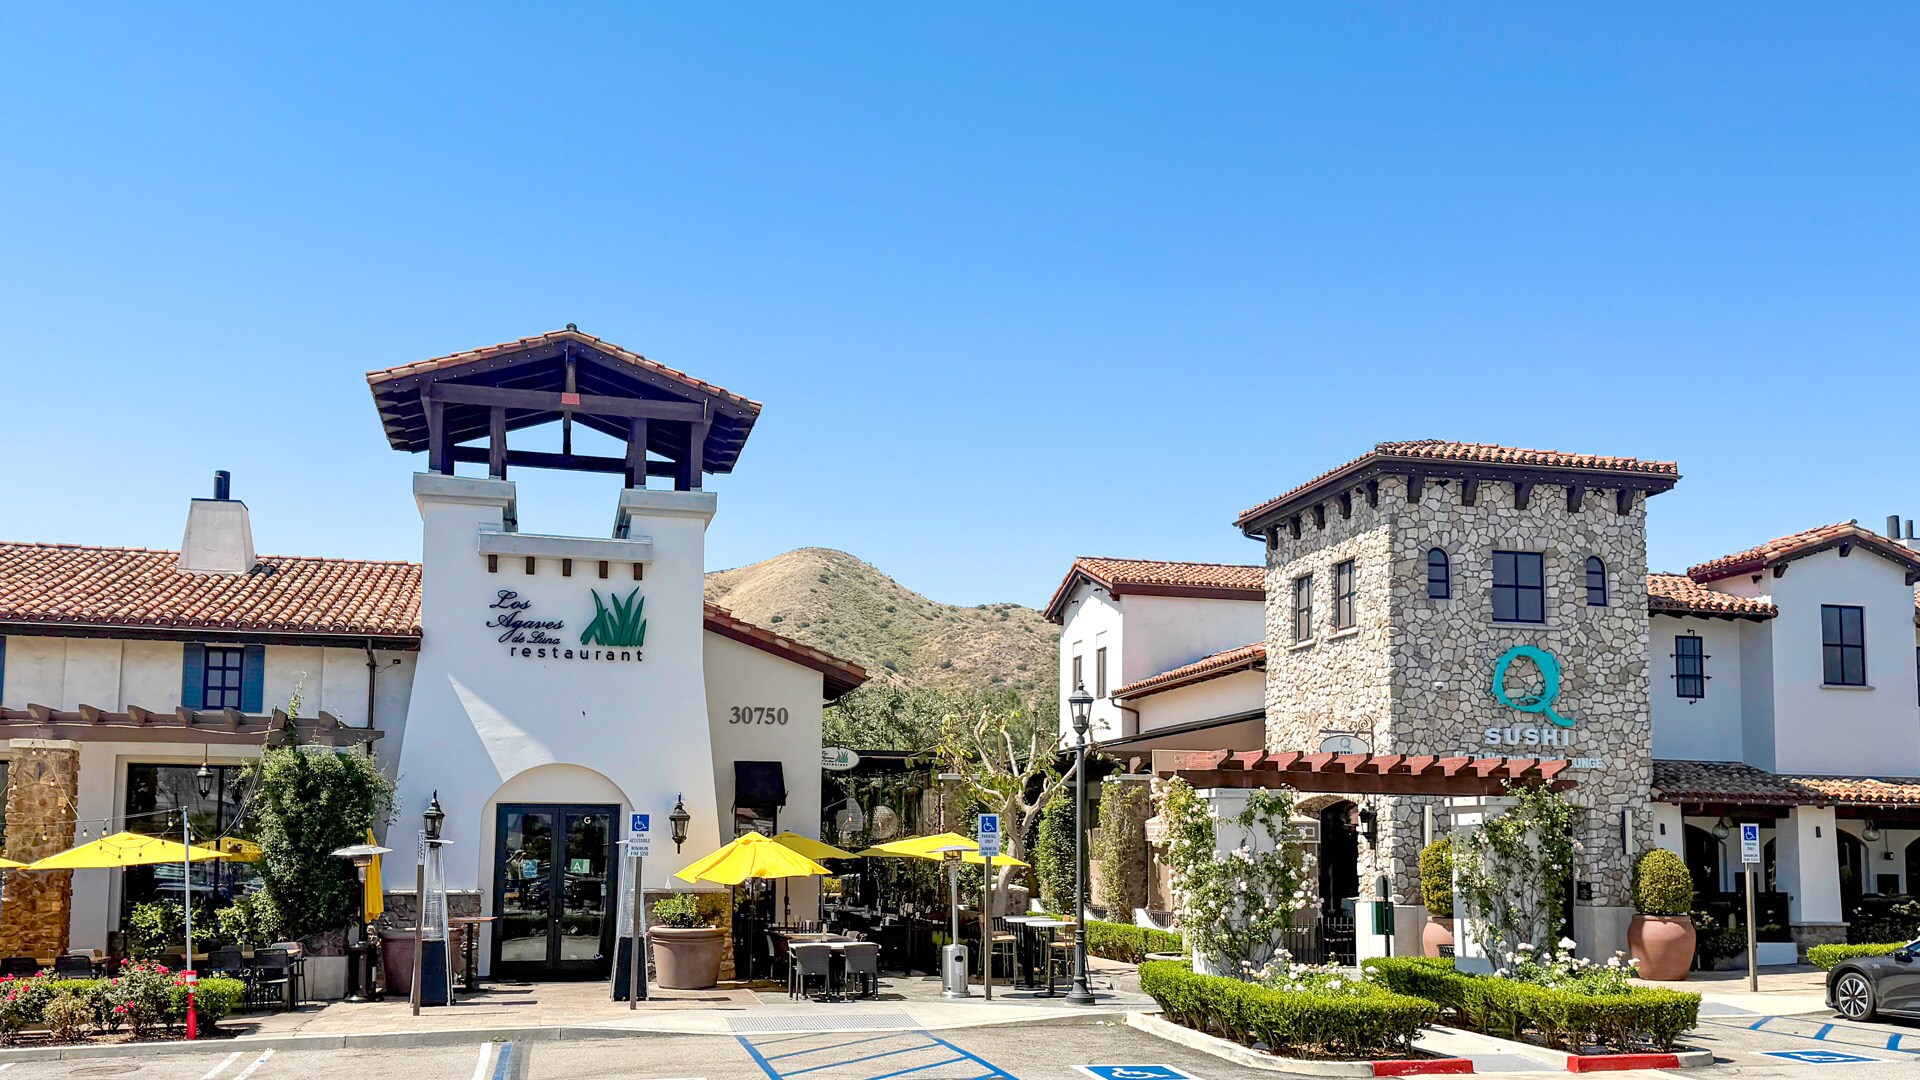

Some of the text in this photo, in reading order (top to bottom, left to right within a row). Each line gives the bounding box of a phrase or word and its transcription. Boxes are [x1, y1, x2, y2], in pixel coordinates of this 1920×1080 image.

[489, 590, 531, 609] Los
[485, 610, 564, 643] Agaves
[511, 631, 560, 645] de Luna
[510, 645, 643, 661] restaurant
[1492, 645, 1576, 727] Q
[729, 706, 789, 725] 30750
[1484, 727, 1570, 747] SUSHI
[583, 816, 592, 824] G
[573, 862, 581, 870] A
